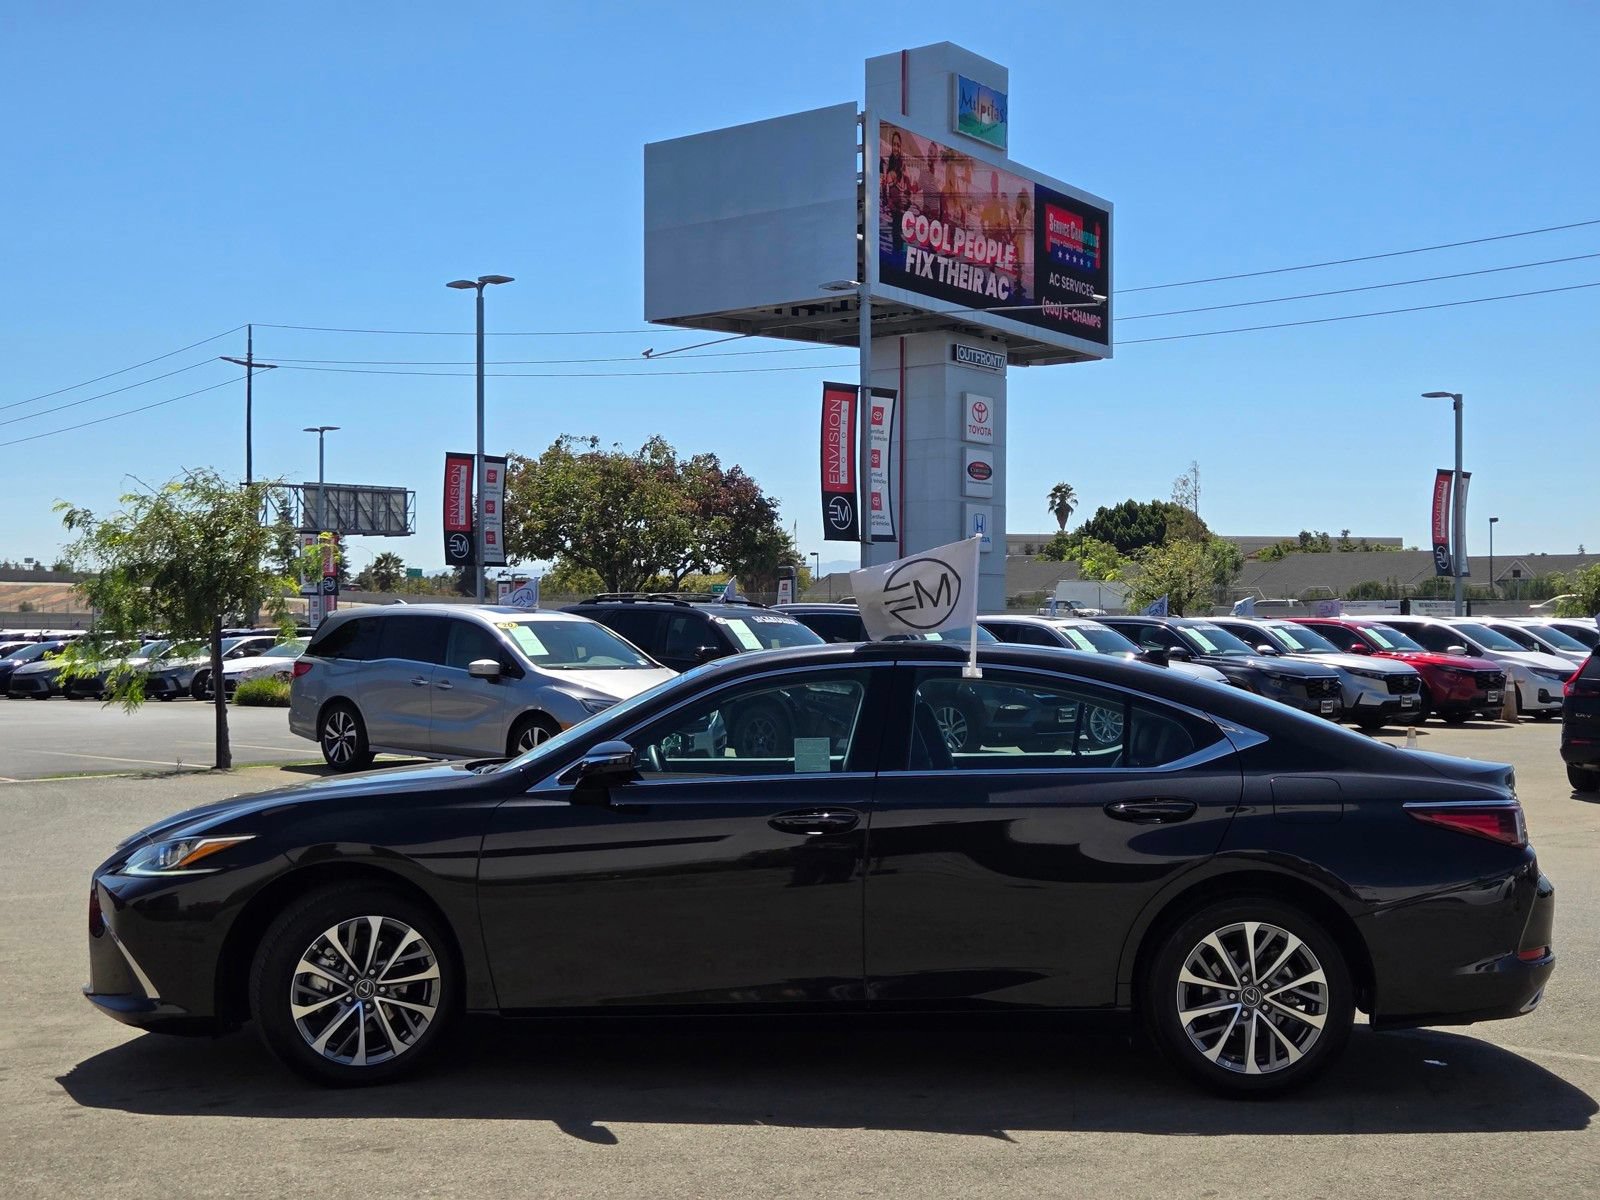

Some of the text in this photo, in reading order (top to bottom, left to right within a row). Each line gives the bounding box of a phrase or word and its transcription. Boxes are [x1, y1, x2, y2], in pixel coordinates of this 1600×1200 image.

[960, 87, 1004, 126] Milpitas
[901, 210, 951, 253] COOL
[953, 227, 1016, 273] PEOPLE
[904, 245, 1010, 301] FIX THEIR AC
[1049, 271, 1095, 298] AC SERVICES
[829, 399, 841, 485] ENVISION
[968, 424, 992, 437] TOYOTA
[450, 464, 462, 526] ENVISION
